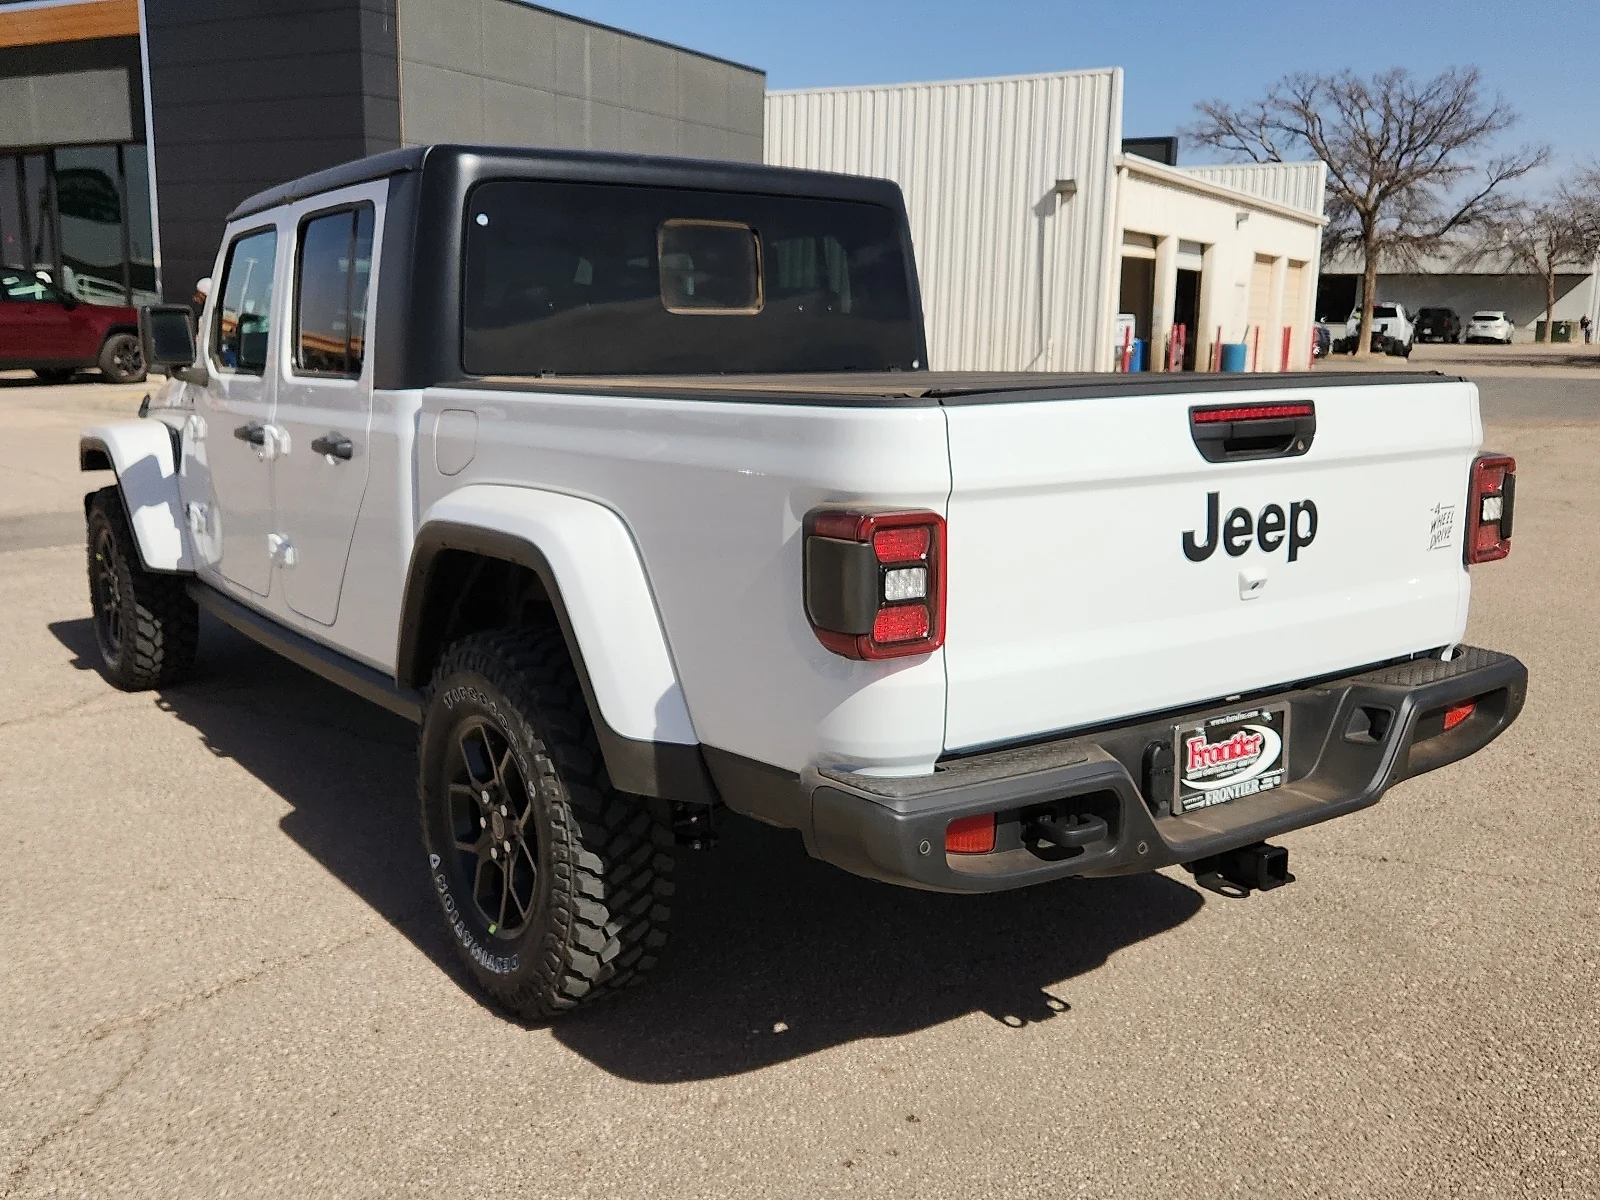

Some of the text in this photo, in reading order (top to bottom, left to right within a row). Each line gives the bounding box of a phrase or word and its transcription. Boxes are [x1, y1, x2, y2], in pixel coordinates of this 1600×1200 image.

[1181, 490, 1318, 564] Jeep
[1187, 731, 1262, 772] Frontier
[1204, 779, 1260, 807] FRONTIER
[435, 873, 520, 976] DESTINATION
